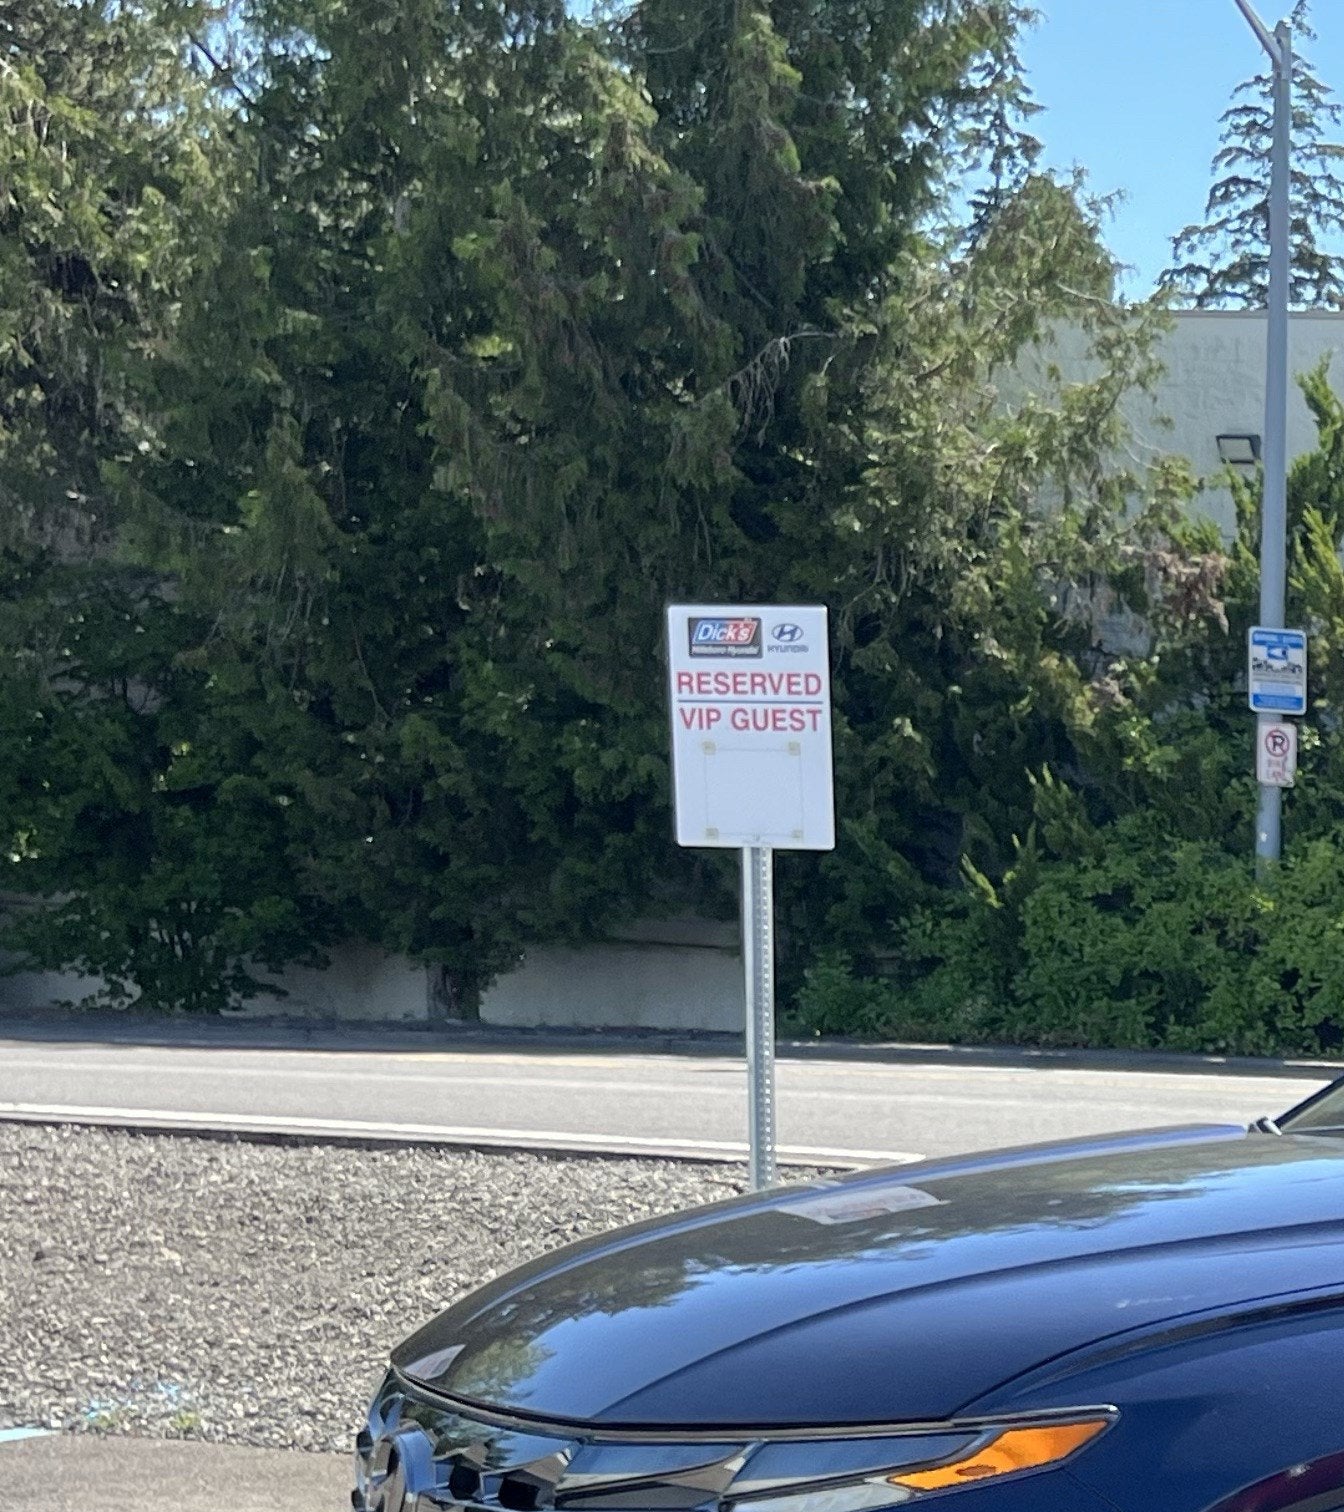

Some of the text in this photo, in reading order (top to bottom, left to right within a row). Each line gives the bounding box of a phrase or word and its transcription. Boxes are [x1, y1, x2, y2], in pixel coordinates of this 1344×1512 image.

[697, 623, 750, 641] Dick's
[677, 672, 821, 696] RESERVED
[679, 708, 822, 732] VIP GUEST
